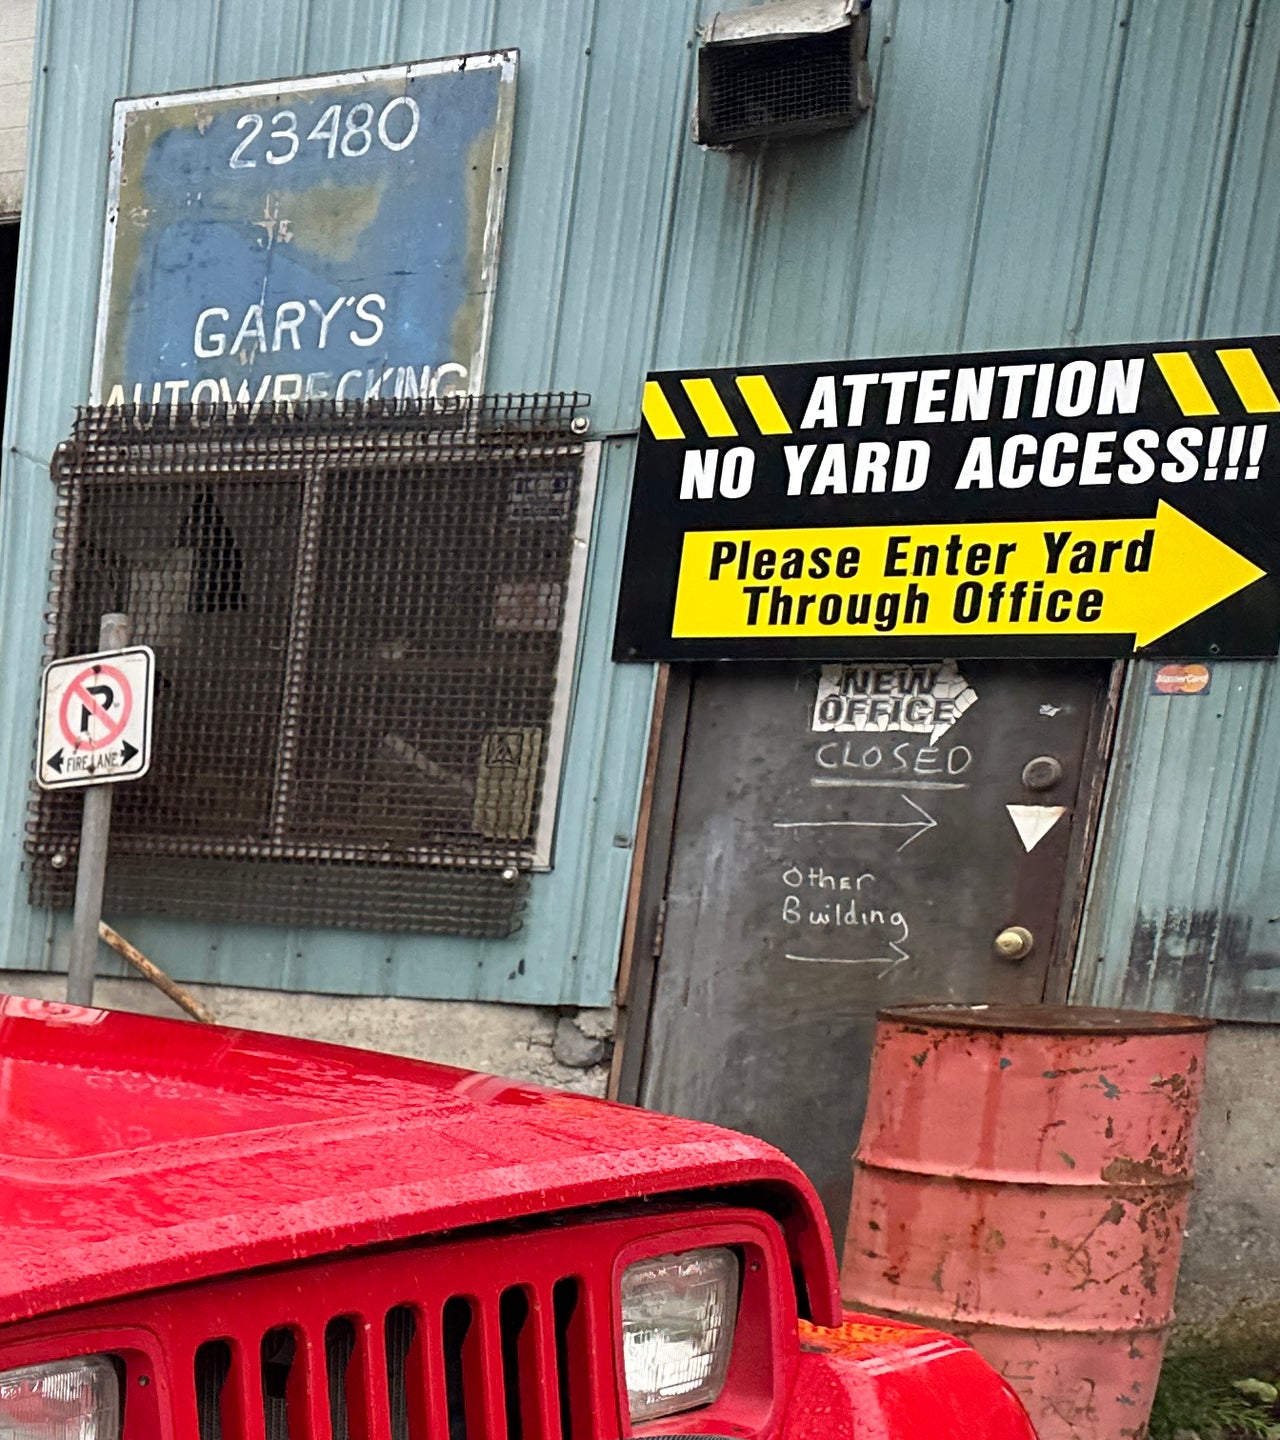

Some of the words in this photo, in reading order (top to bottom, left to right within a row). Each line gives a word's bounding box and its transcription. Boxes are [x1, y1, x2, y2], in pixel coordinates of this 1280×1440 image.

[228, 96, 420, 168] 23480
[194, 294, 387, 359] GARY'S
[800, 358, 1145, 430] ATTENTION
[679, 446, 756, 500] NO
[784, 439, 931, 496] YARD
[955, 425, 1268, 490] ACCESS!!!
[709, 539, 860, 581] Please
[884, 537, 1017, 578] Enter
[1043, 529, 1156, 575] Yard
[742, 583, 931, 632] Through
[954, 580, 1104, 623] Office
[841, 667, 938, 696] NEW
[818, 693, 956, 725] OFFICE
[66, 755, 89, 772] FIRE
[815, 742, 972, 775] CLOSED
[782, 867, 876, 892] Other
[782, 895, 909, 944] Building
